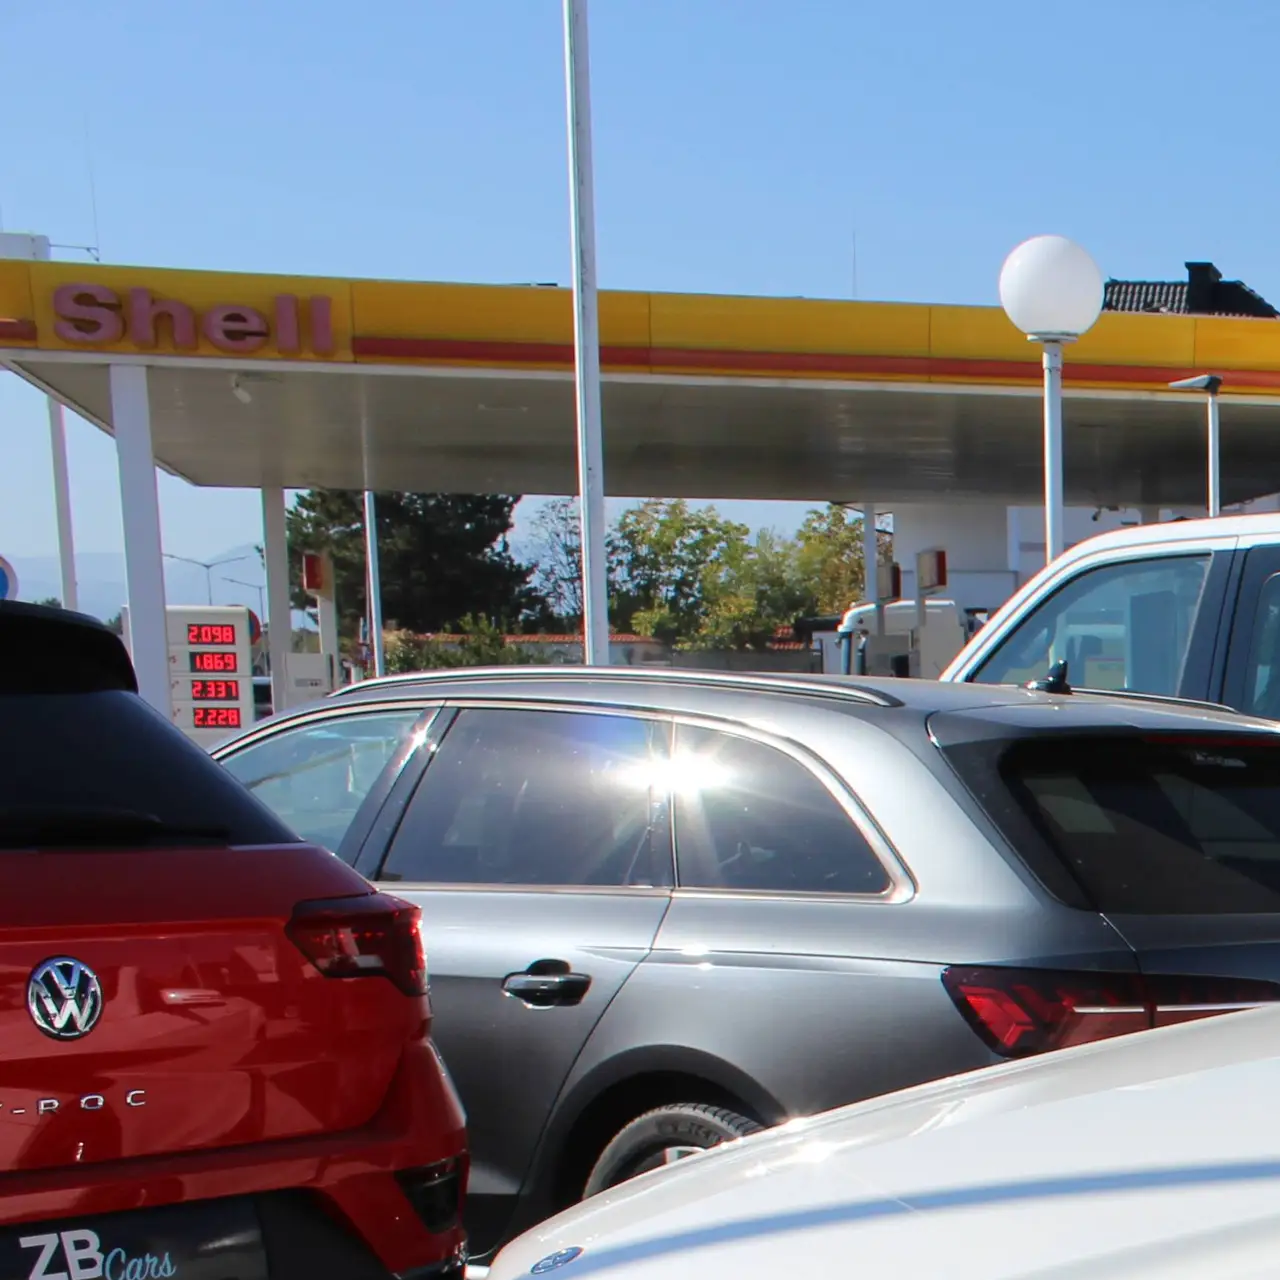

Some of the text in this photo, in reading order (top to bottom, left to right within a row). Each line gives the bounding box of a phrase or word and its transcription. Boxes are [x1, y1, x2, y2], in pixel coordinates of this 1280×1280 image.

[53, 283, 335, 357] Shell
[188, 625, 234, 643] 2.098
[195, 653, 235, 671] 1.869
[192, 681, 237, 698] 2.337
[194, 708, 239, 726] 2.228
[0, 1089, 146, 1115] -ROC
